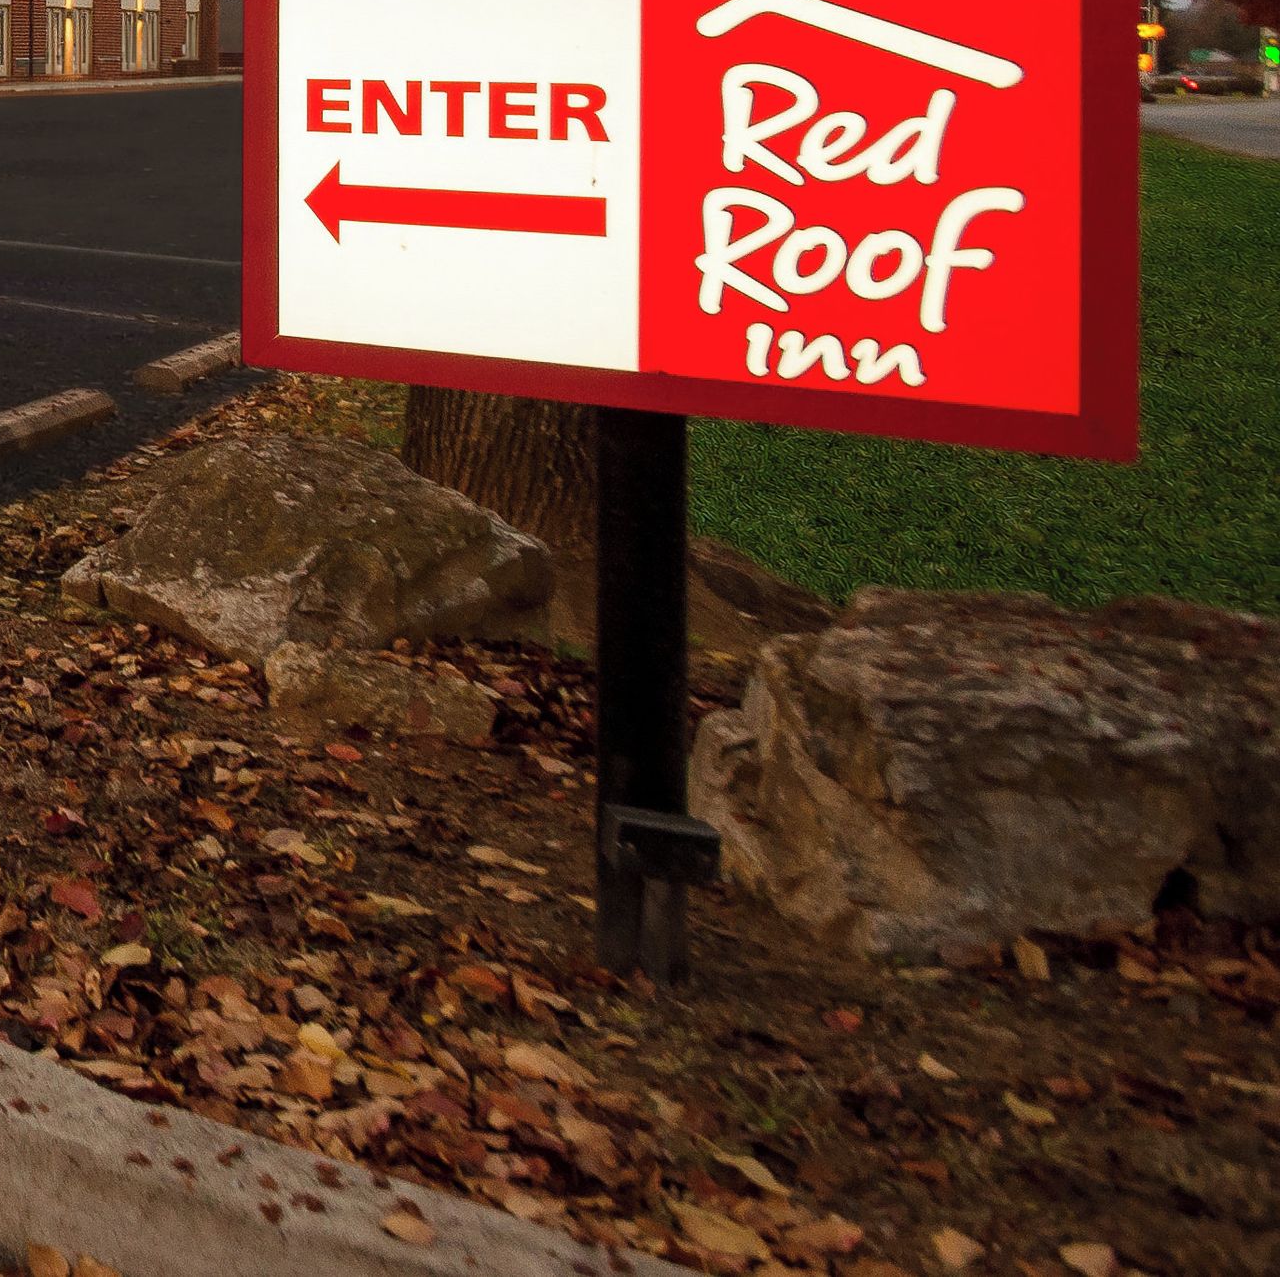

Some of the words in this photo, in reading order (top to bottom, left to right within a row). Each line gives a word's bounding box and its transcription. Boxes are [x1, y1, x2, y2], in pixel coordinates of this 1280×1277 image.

[307, 79, 609, 142] ENTER
[721, 63, 956, 186] Red
[694, 187, 1024, 333] Roof
[745, 323, 926, 387] inn
